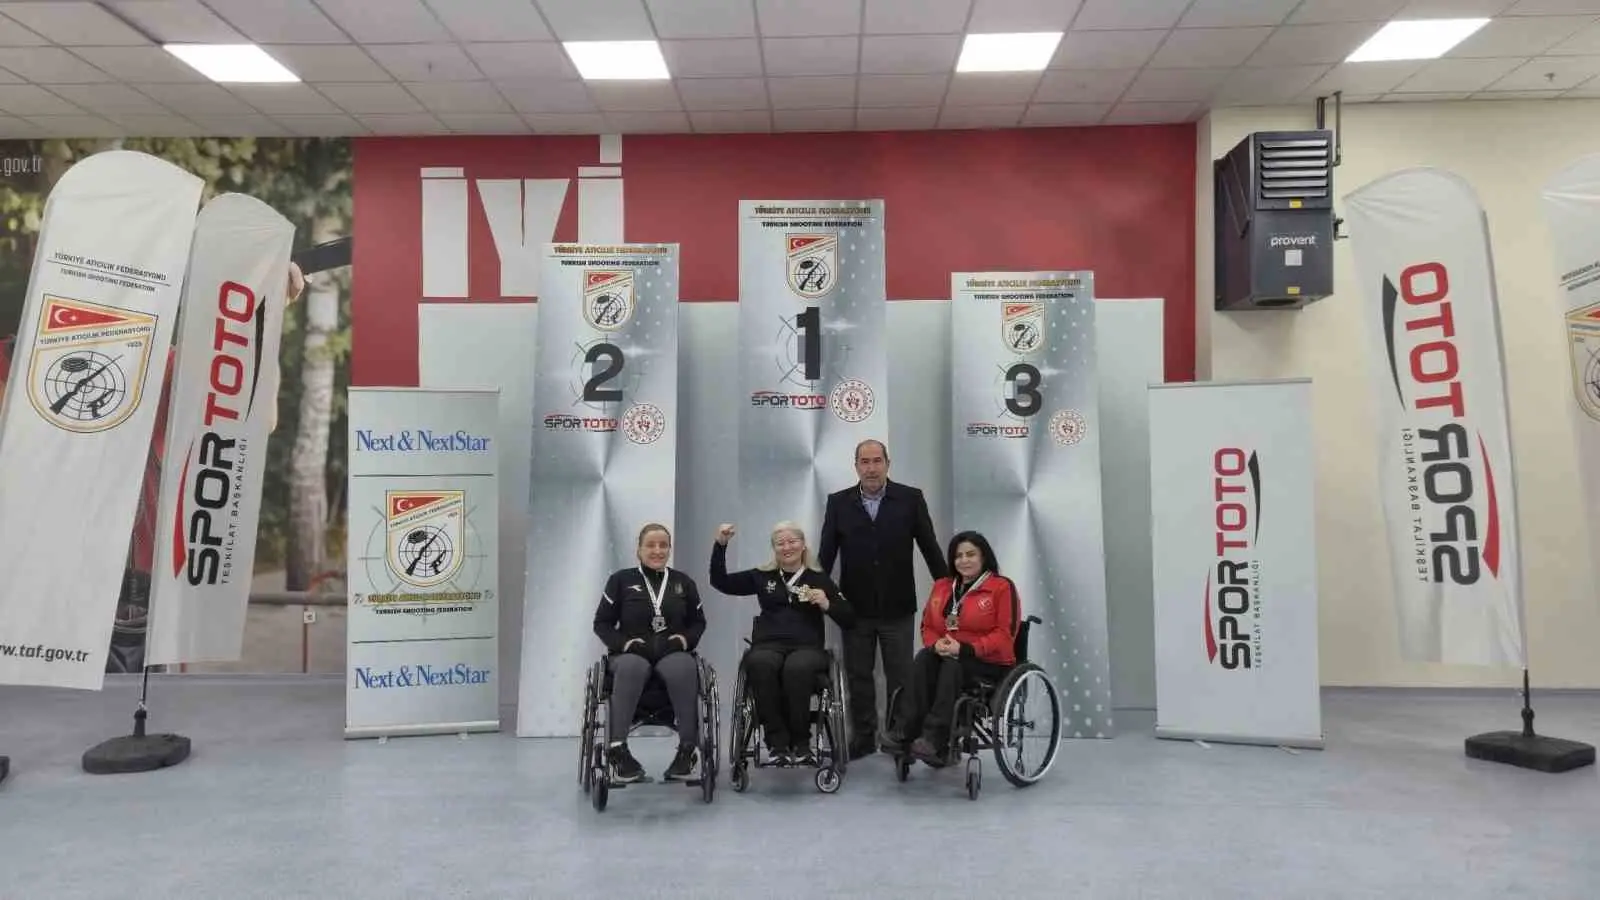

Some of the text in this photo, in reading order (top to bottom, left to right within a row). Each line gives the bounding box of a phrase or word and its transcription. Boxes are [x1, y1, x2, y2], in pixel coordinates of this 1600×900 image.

[1270, 235, 1316, 247] provent
[796, 306, 821, 380] 1
[583, 343, 625, 402] 2
[1004, 363, 1042, 416] 3
[355, 430, 491, 451] Next & NextStar
[354, 663, 491, 689] Next & NextStar
